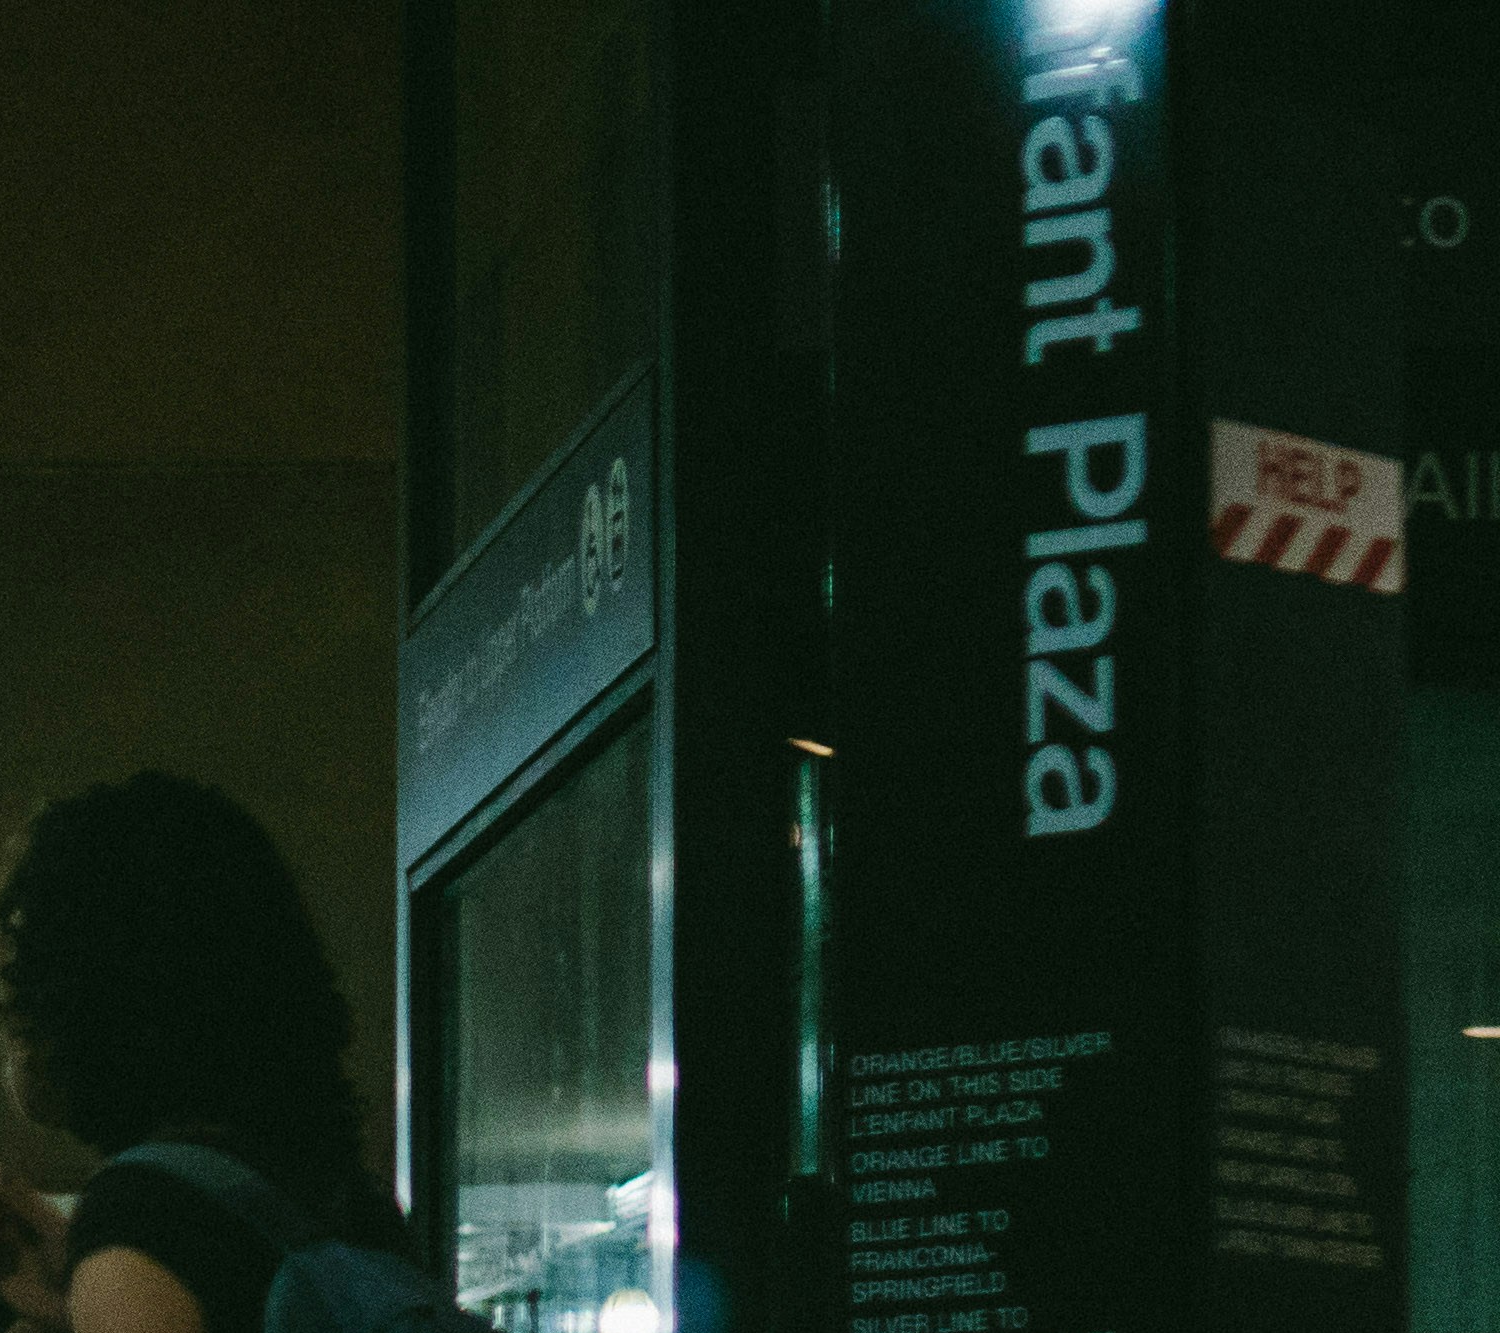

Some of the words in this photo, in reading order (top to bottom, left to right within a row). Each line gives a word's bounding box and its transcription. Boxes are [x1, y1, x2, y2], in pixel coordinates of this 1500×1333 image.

[1256, 436, 1362, 513] HELP
[1023, 412, 1148, 837] Plaza
[850, 1031, 1113, 1077] ORANGE/BLUE/SILVER
[850, 1082, 899, 1108] LINE
[908, 1079, 941, 1103] ON
[949, 1071, 1002, 1097] THIS
[1009, 1067, 1063, 1093] SIDE
[850, 1107, 956, 1139] L'ENFANT
[965, 1100, 1044, 1126] PLAZA
[850, 1145, 949, 1174] ORANGE
[957, 1139, 1010, 1165] LINE
[1016, 1136, 1050, 1160] TO
[851, 1179, 937, 1204] VIENNA
[850, 1218, 911, 1244] BLUE
[919, 1214, 969, 1239] LINE
[977, 1210, 1011, 1233] TO
[851, 1271, 1007, 1304] SPRINGFIELD
[937, 1309, 988, 1333] LINE
[996, 1306, 1029, 1329] TO
